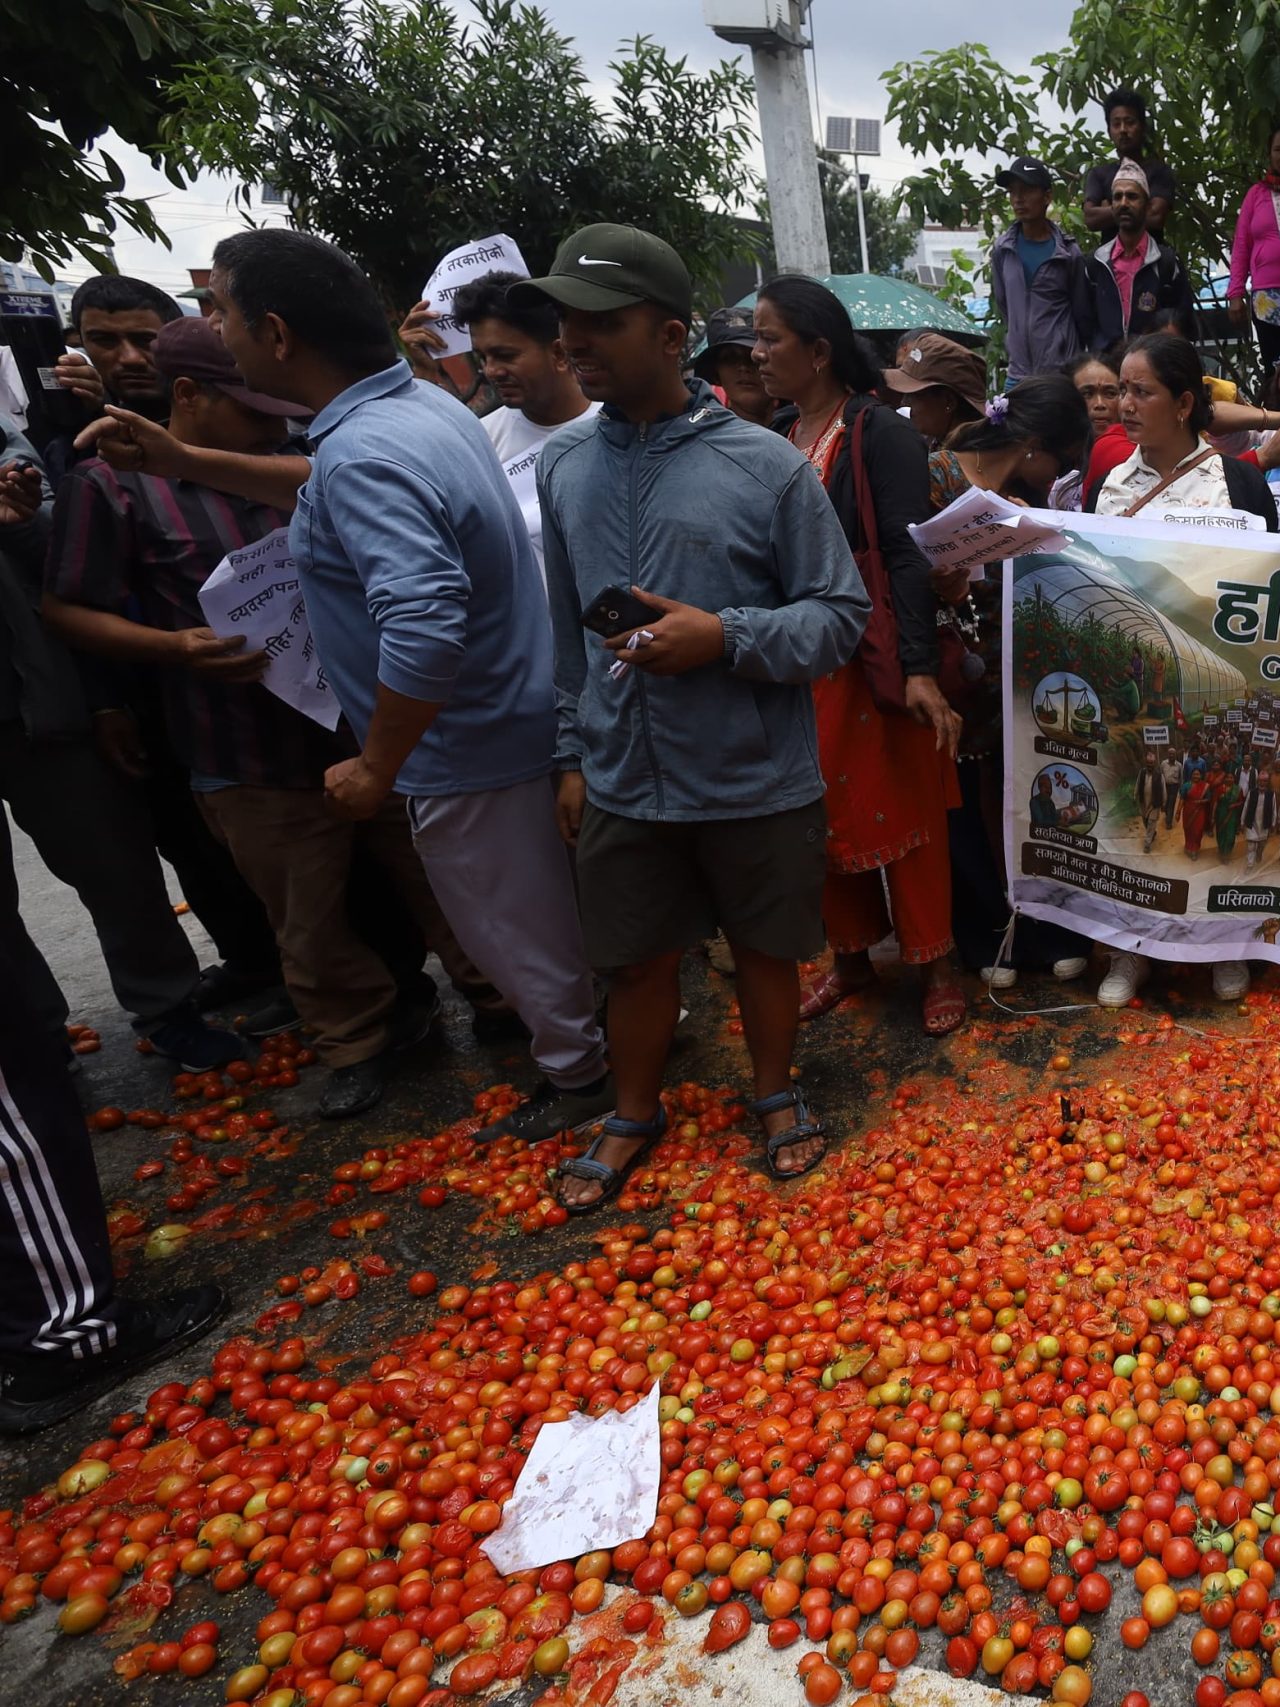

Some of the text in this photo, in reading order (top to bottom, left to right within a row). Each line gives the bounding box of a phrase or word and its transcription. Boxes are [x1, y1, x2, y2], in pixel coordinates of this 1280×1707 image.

[447, 243, 505, 272] तरकारीको
[238, 564, 265, 584] सही
[227, 580, 300, 622] व्यवस्थापन
[1051, 865, 1088, 886] अधिकार
[1070, 858, 1088, 870] मल
[1091, 864, 1098, 874] र
[1122, 870, 1172, 894] किसानको
[1217, 889, 1275, 907] पसिनाको
